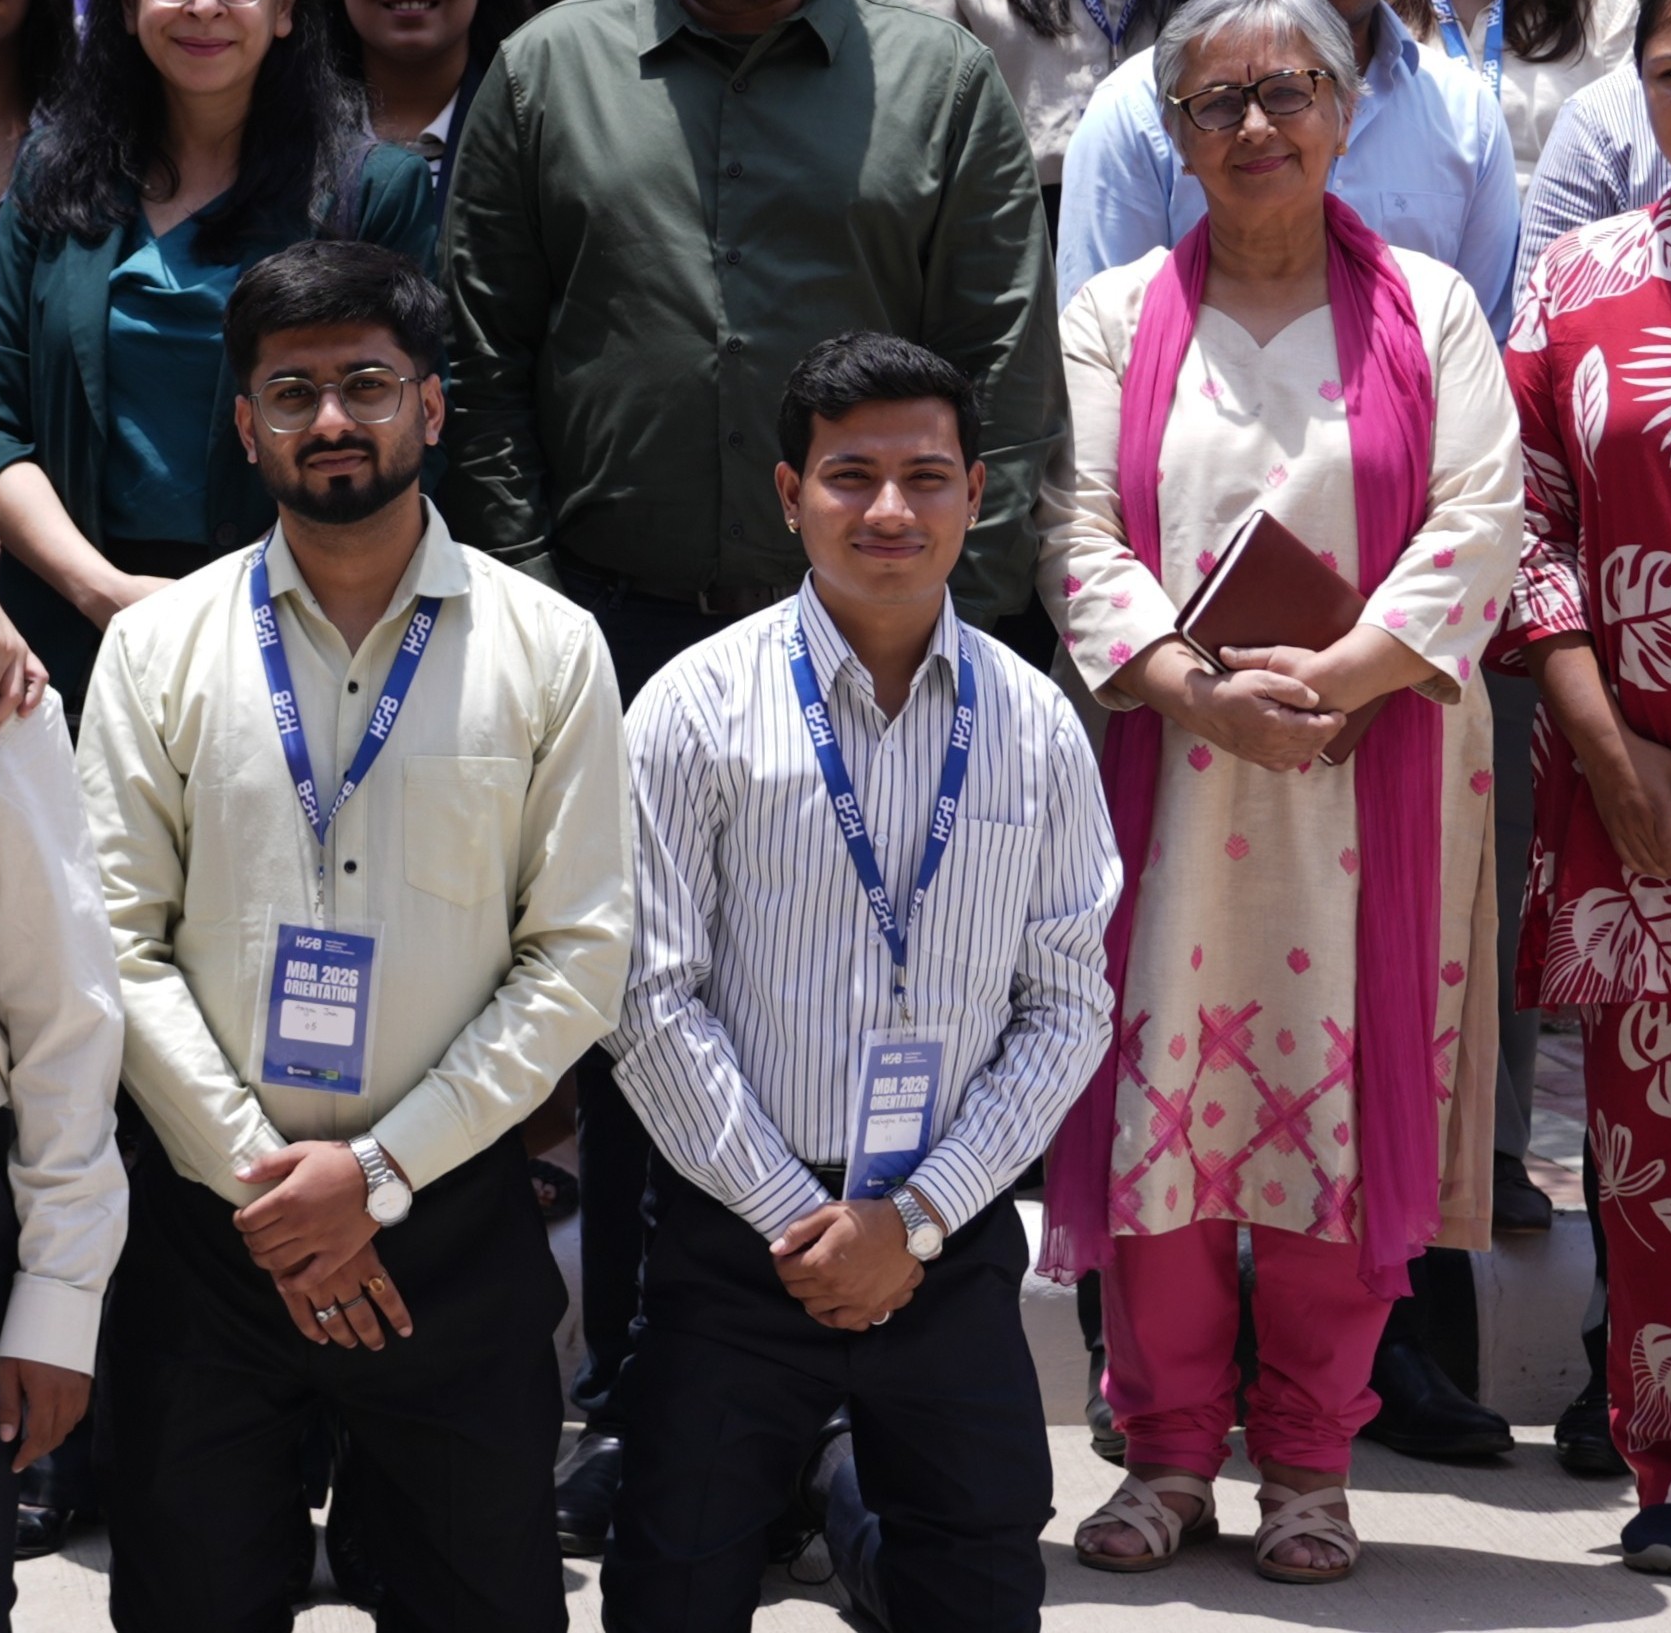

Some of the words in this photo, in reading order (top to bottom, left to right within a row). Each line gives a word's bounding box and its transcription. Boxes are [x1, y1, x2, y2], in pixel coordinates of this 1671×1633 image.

[253, 604, 279, 648] HSB
[402, 611, 433, 657] HSB
[272, 690, 300, 736] HSB
[368, 695, 400, 741] HSB
[804, 701, 835, 748] HSB
[951, 705, 973, 750] HSB
[297, 778, 320, 826] HSB
[834, 791, 865, 840] HSB
[931, 795, 957, 843] HSB
[868, 885, 896, 931] HSB
[295, 935, 322, 951] HSB
[284, 979, 357, 1003] ORIENTATION
[286, 960, 318, 981] MBA
[321, 965, 359, 987] 2026
[880, 1053, 903, 1065] HSB
[870, 1092, 927, 1111] ORIENTATION
[872, 1077, 899, 1095] MBA
[900, 1075, 930, 1093] 2026
